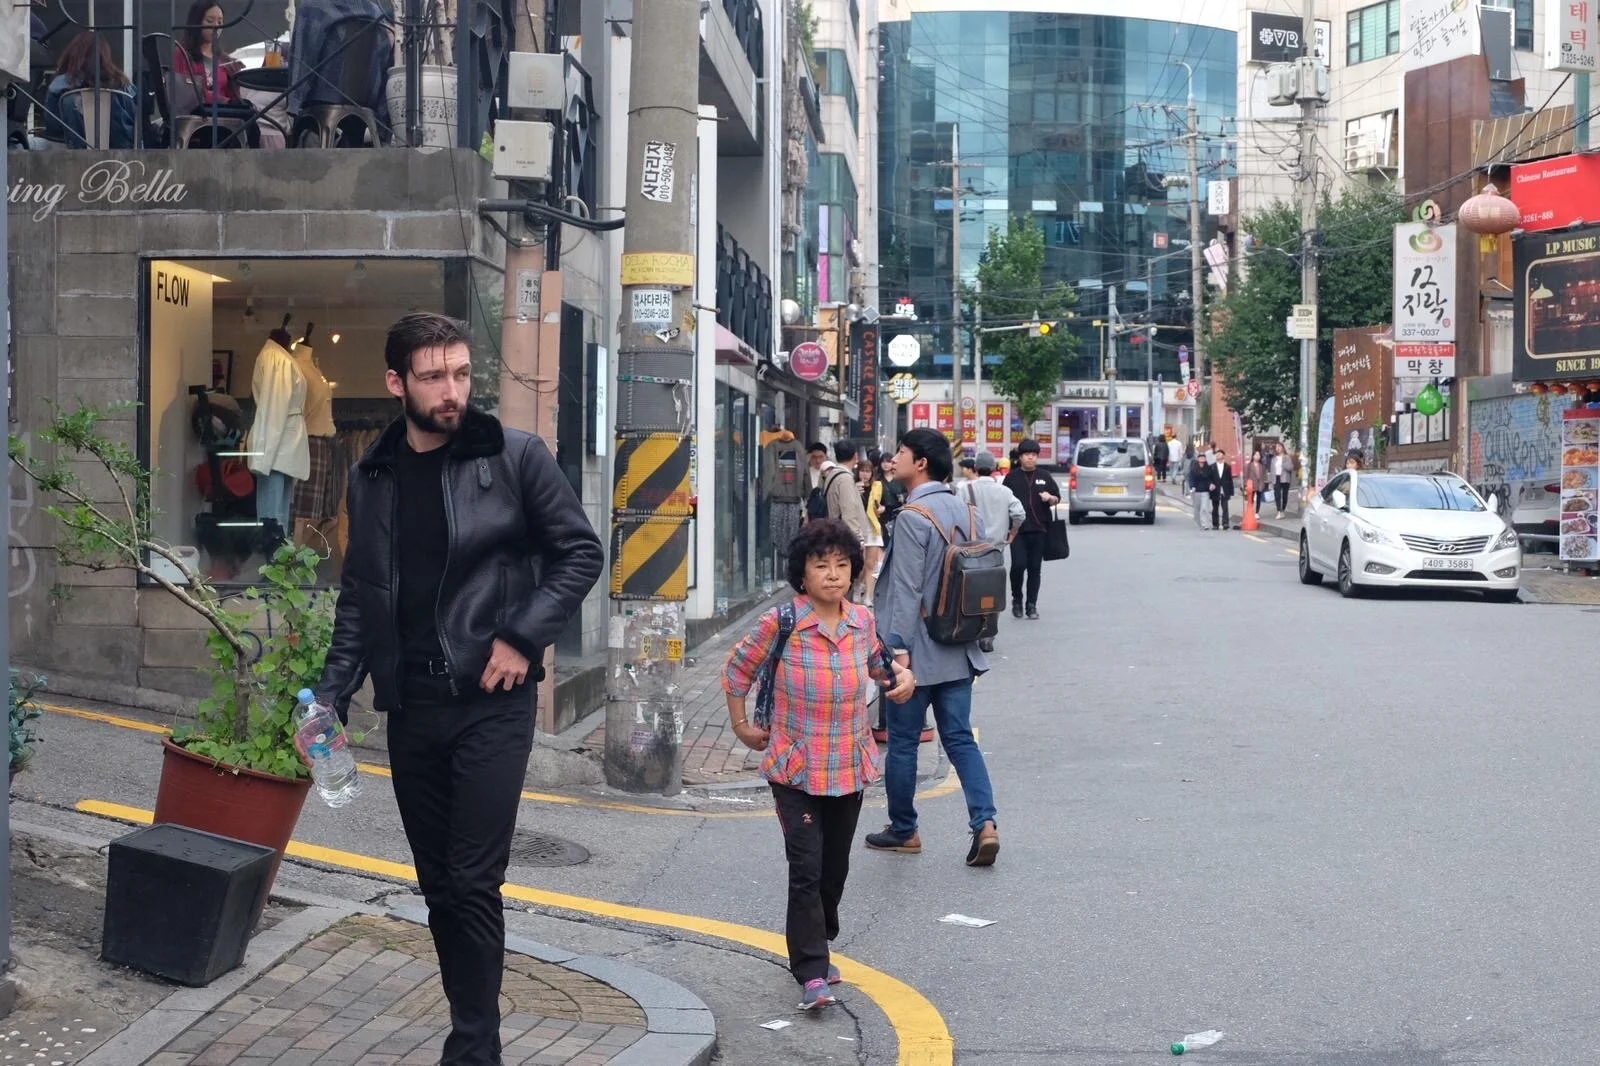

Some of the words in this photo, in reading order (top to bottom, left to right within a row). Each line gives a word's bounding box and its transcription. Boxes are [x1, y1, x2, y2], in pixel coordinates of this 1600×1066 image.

[1516, 172, 1542, 184] Chinese
[1542, 165, 1577, 179] Restaurant
[7, 177, 68, 222] ing
[78, 159, 188, 204] Bella
[1545, 241, 1560, 255] LP
[1562, 236, 1597, 254] MUSIC
[157, 270, 190, 308] FLOW
[640, 293, 671, 307] 사다리차
[1402, 288, 1448, 324] 지락
[1401, 328, 1440, 337] 337-0037
[1555, 358, 1587, 372] SINCE
[1448, 559, 1469, 568] 3588
